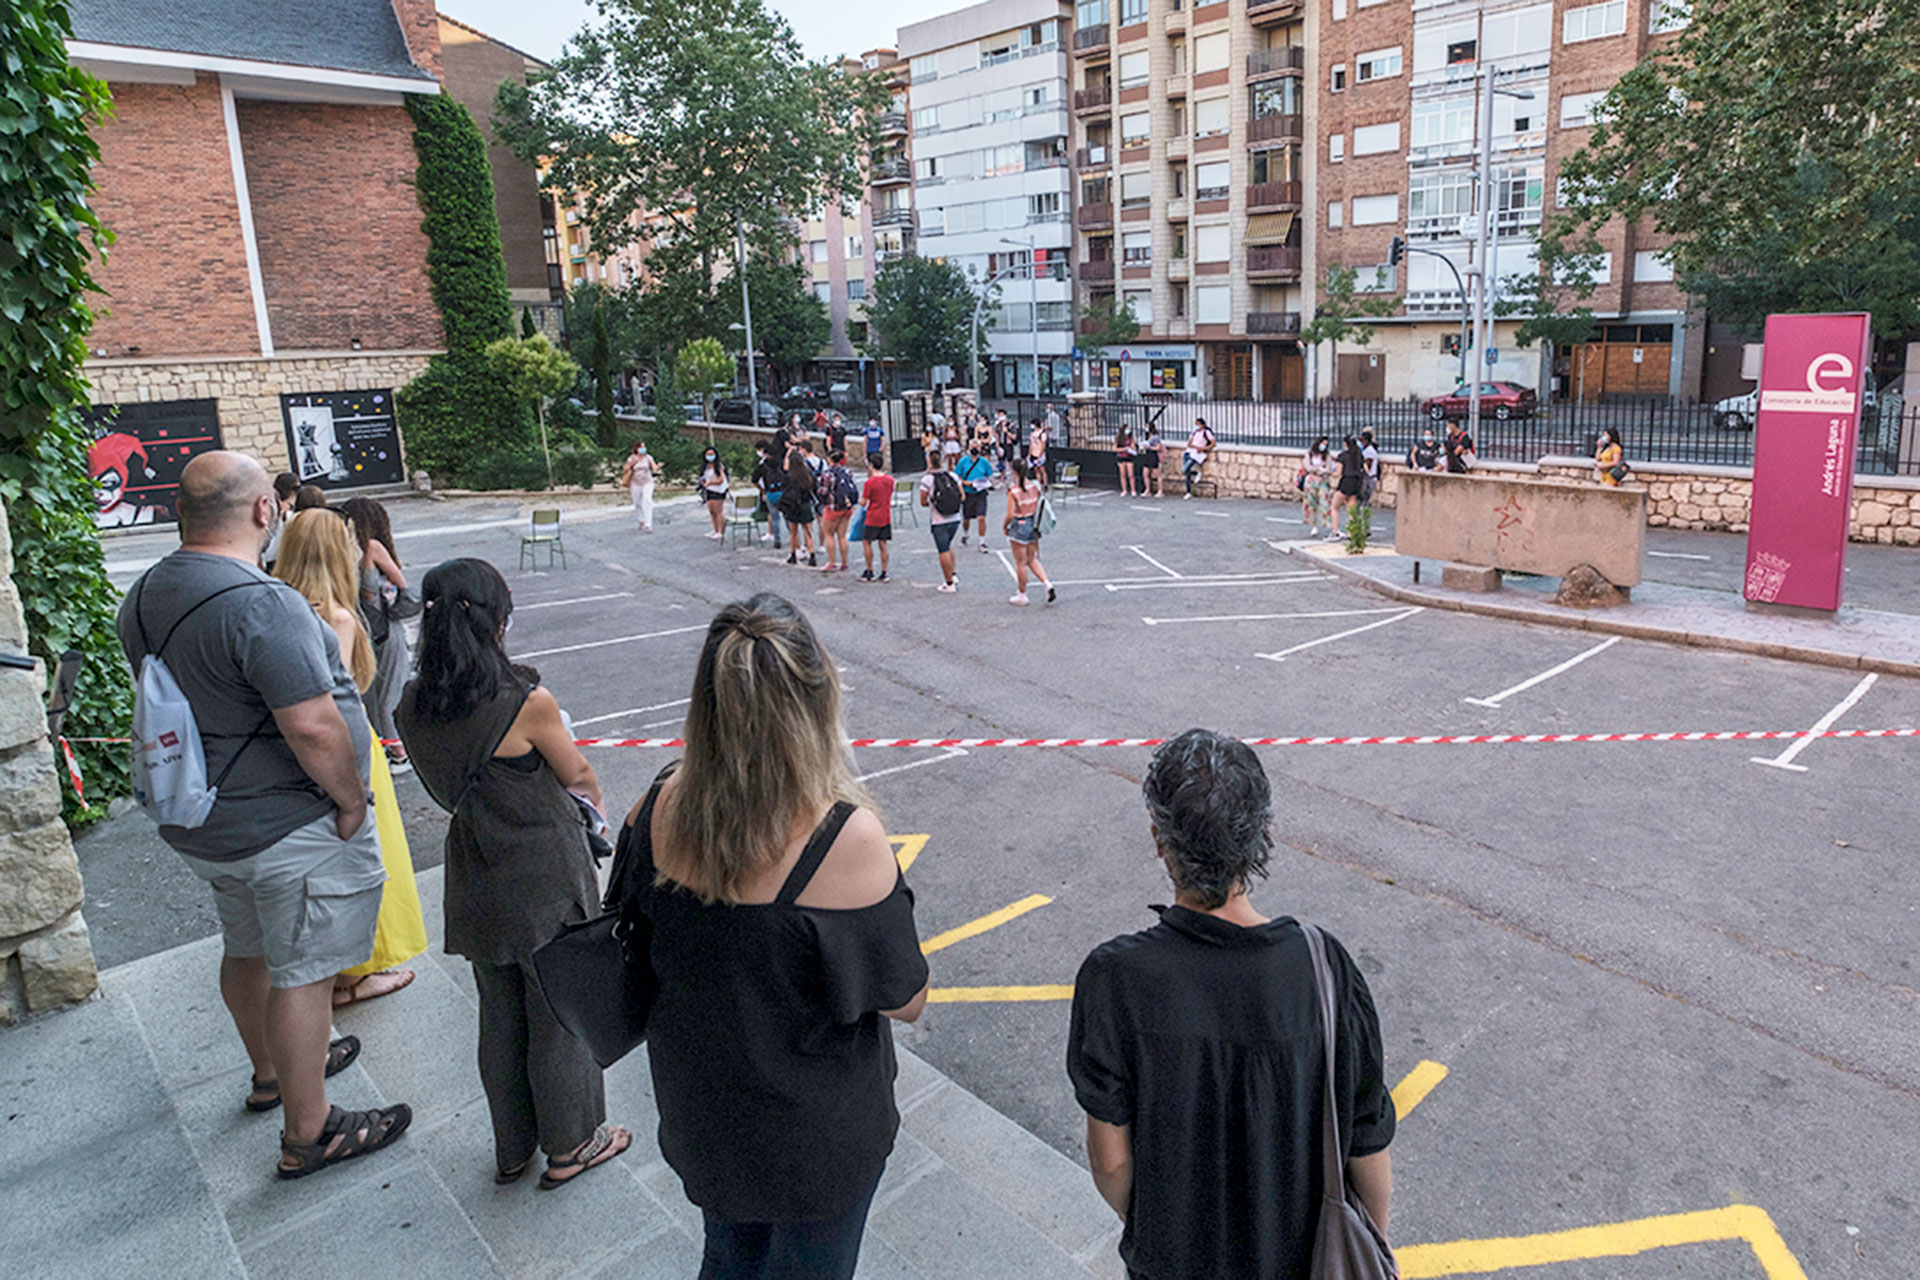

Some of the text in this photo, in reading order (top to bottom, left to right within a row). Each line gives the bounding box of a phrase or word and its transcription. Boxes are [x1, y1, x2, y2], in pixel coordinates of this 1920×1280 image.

[1145, 350, 1162, 358] TATA
[1806, 353, 1853, 393] e
[1821, 419, 1840, 496] Andrés Laguna
